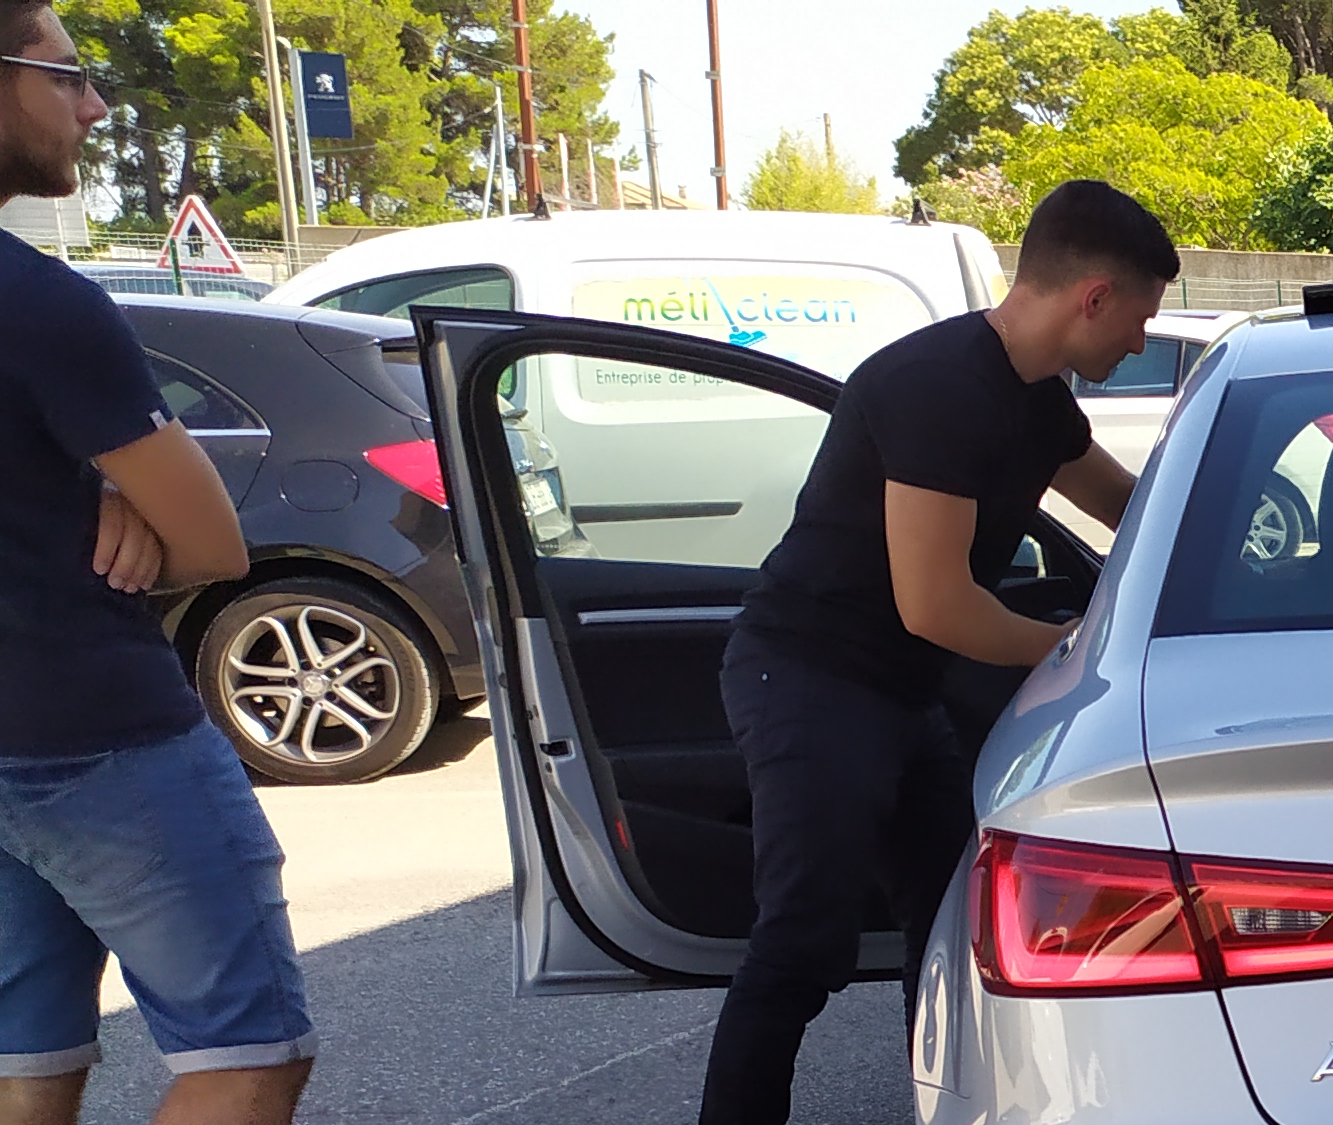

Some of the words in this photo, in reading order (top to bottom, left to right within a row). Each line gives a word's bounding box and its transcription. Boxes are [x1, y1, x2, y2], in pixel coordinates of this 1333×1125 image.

[623, 291, 709, 321] méli
[595, 369, 662, 386] Entreprise
[669, 371, 687, 384] de
